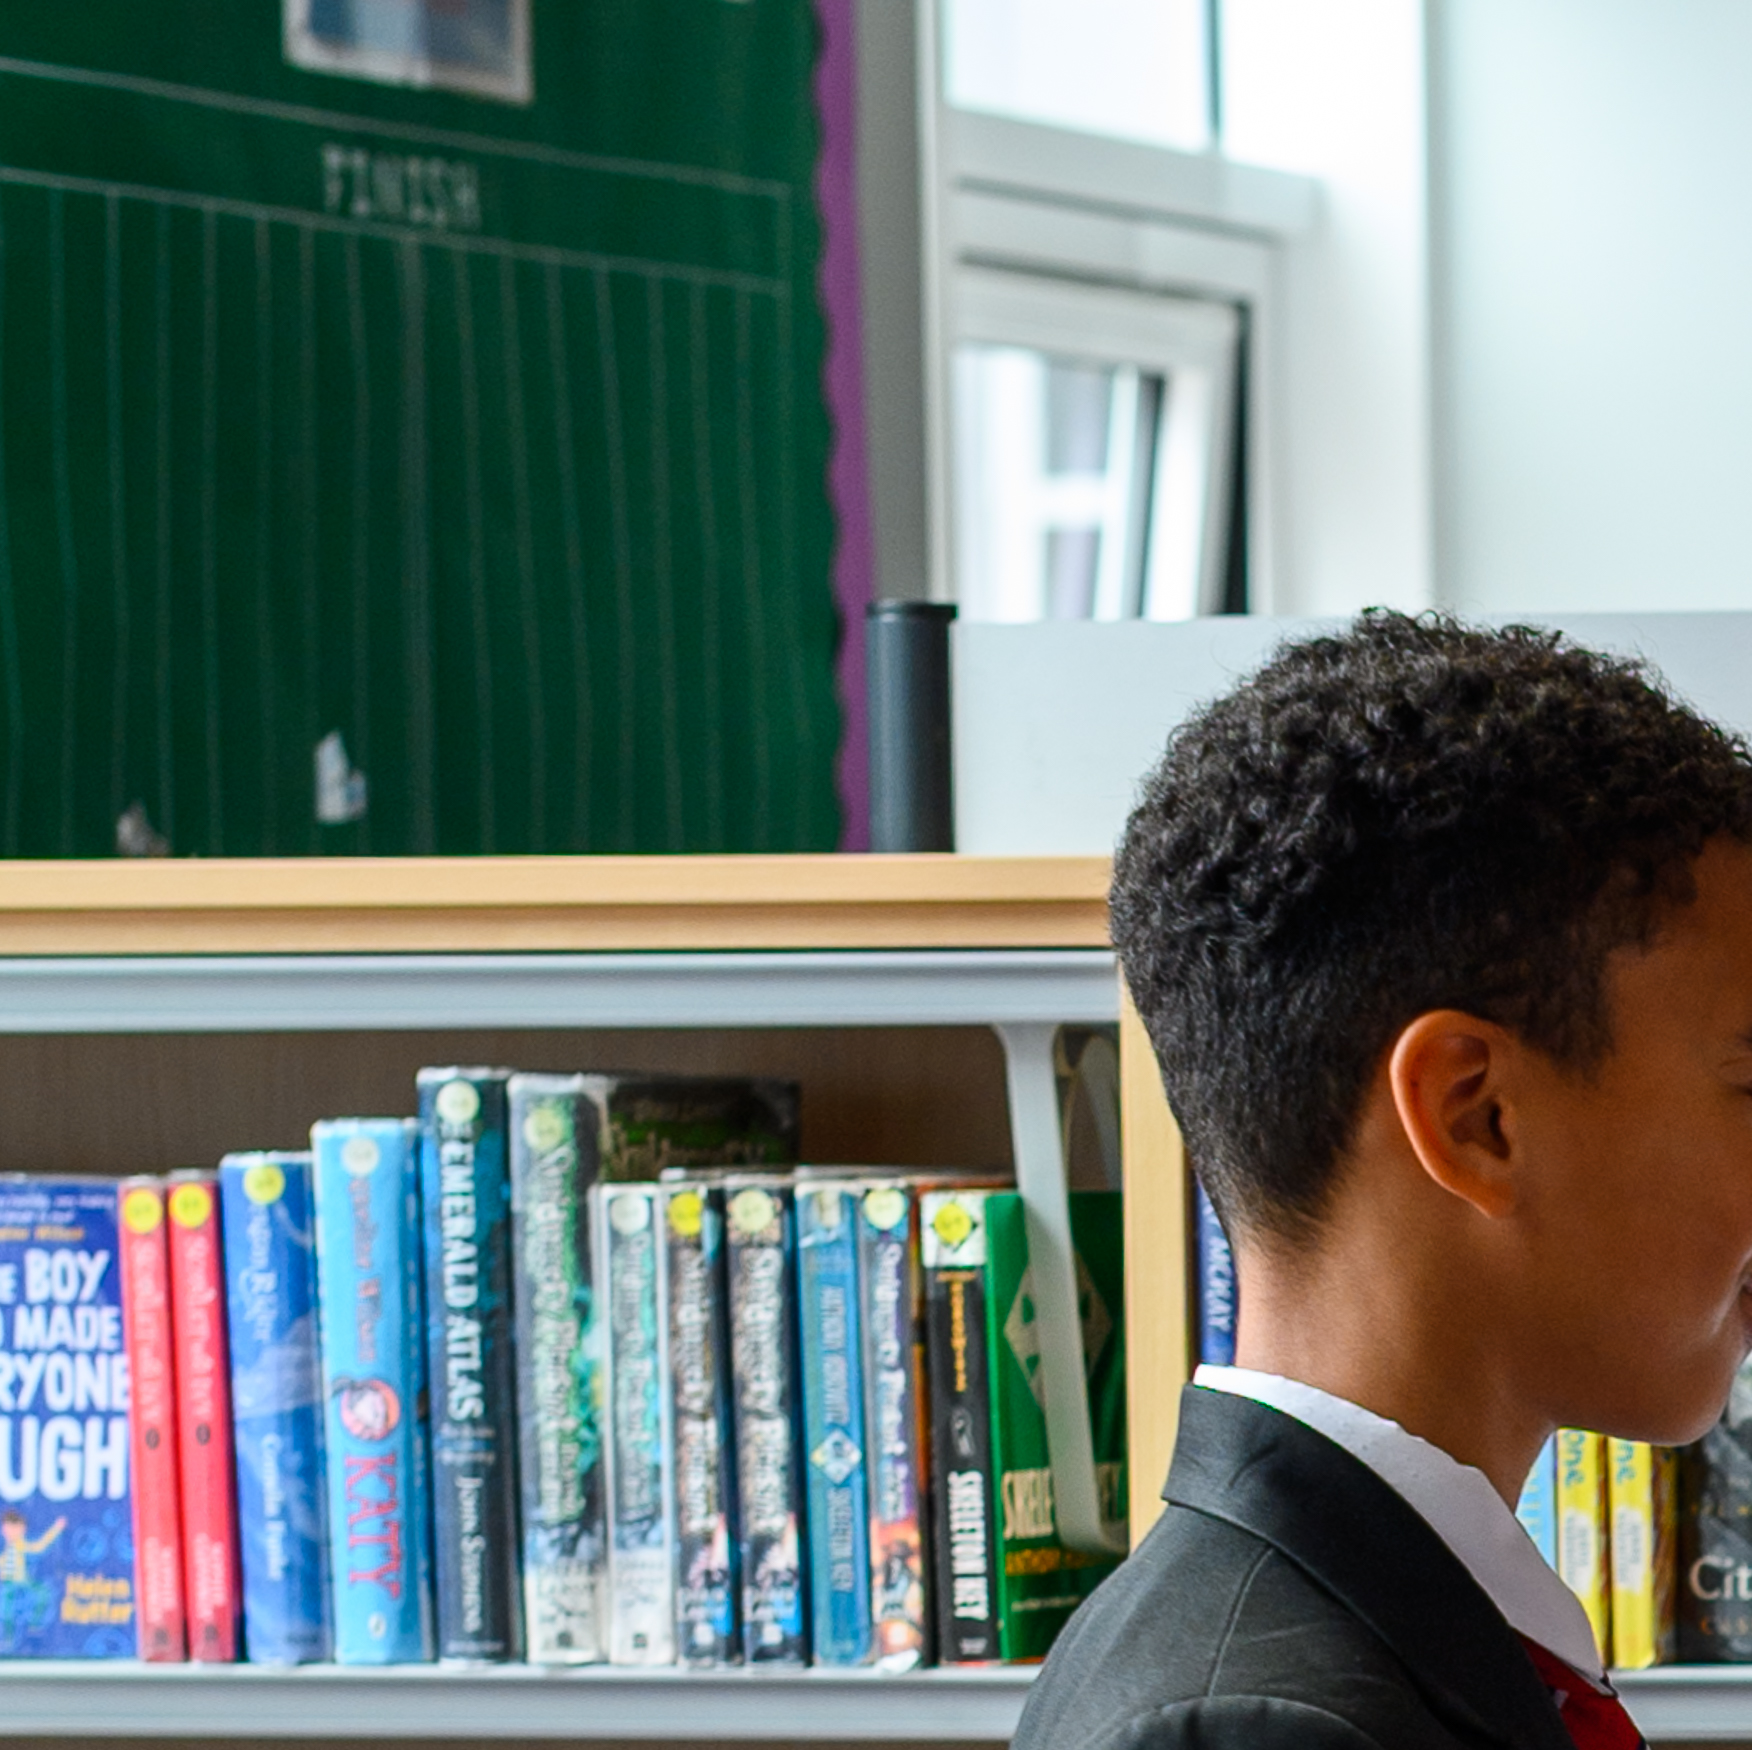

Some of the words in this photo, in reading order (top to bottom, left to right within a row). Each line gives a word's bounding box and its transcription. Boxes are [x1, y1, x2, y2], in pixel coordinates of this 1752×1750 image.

[320, 143, 483, 230] FINISH
[438, 1140, 480, 1307] EMERALD
[24, 1248, 110, 1304] BOY
[13, 1303, 121, 1350] MADE
[446, 1315, 484, 1421] ATLAS
[344, 1452, 403, 1598] KATY
[947, 1469, 987, 1574] SKELETON
[954, 1575, 989, 1621] KEY
